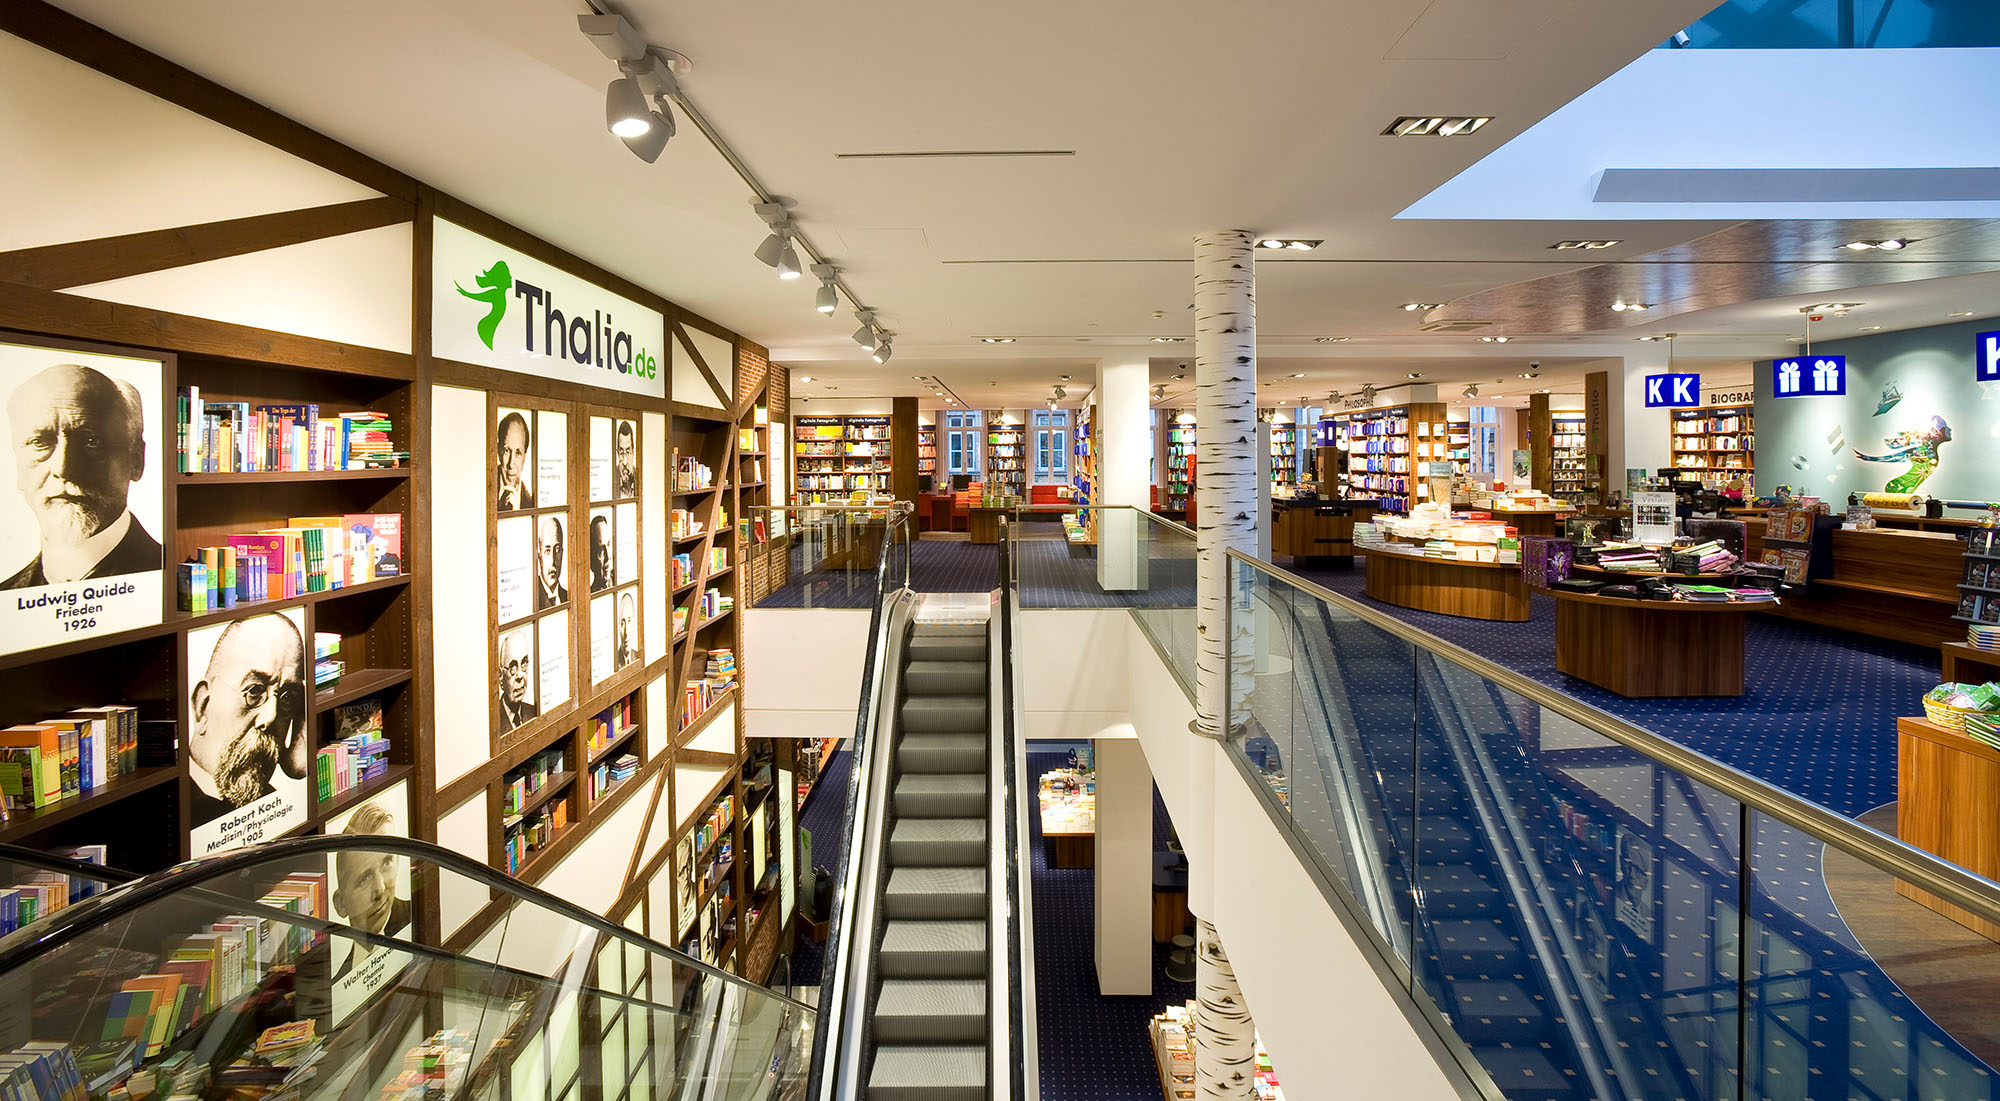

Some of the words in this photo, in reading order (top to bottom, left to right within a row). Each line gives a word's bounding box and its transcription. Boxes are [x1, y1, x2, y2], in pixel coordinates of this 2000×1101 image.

[1649, 378, 1664, 403] K
[1673, 377, 1694, 402] K
[18, 591, 77, 610] Ludwig
[83, 582, 135, 600] Quidde
[56, 604, 103, 619] Frieden
[64, 618, 96, 632] 1926
[220, 810, 255, 833] Robert
[258, 797, 282, 815] Koch
[206, 804, 294, 853] Medizin/Physiologie
[242, 829, 263, 846] 1905
[343, 965, 369, 990] Walter
[362, 963, 385, 985] Chemie
[366, 974, 382, 991] 1937
